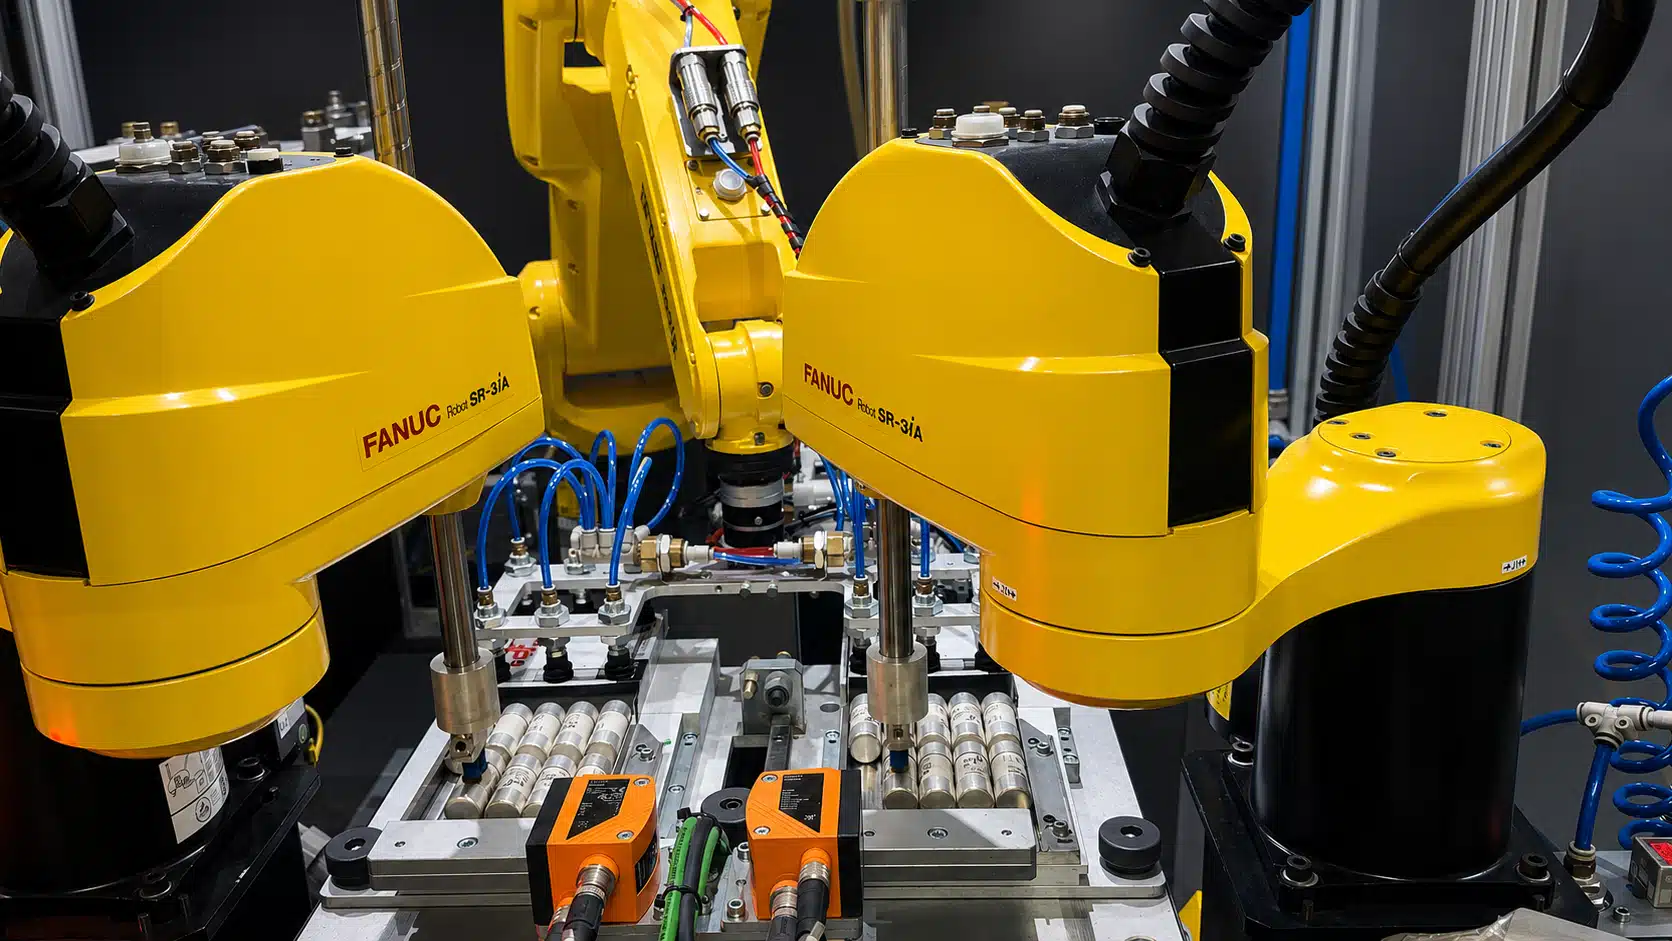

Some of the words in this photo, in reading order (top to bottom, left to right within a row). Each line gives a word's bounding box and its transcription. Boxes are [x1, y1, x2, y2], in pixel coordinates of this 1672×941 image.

[362, 403, 442, 459] FANUC
[446, 400, 469, 419] Robot
[470, 372, 510, 407] SR-3iA
[804, 363, 854, 406] FANUC
[857, 398, 876, 419] Robot
[877, 407, 924, 442] SR-3iA
